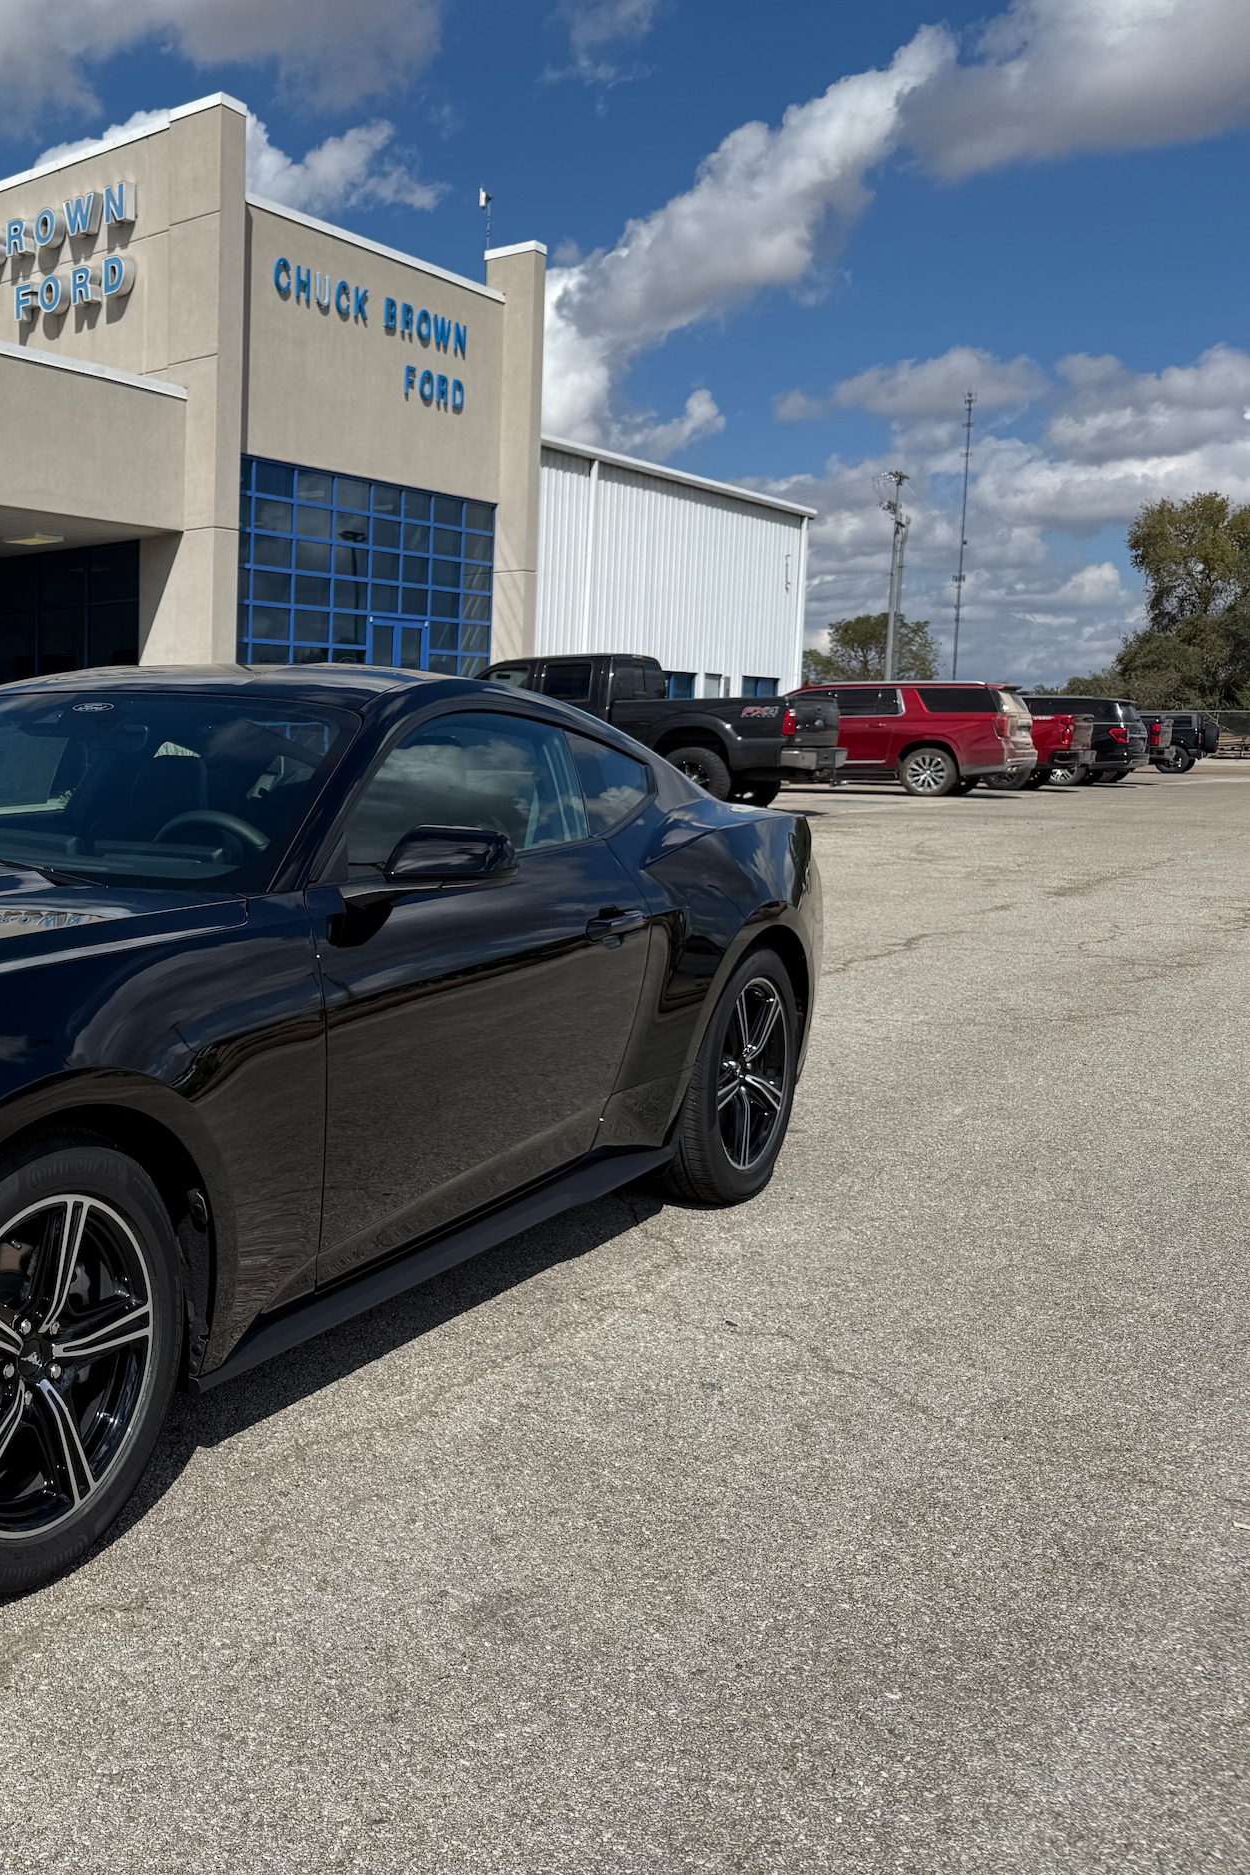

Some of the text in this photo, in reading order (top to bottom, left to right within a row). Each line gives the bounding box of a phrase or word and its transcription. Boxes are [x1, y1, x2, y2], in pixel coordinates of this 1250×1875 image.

[14, 255, 132, 322] FORD
[274, 257, 467, 354] CHUCK BROWN
[404, 365, 465, 408] FORD
[741, 706, 780, 717] FX4
